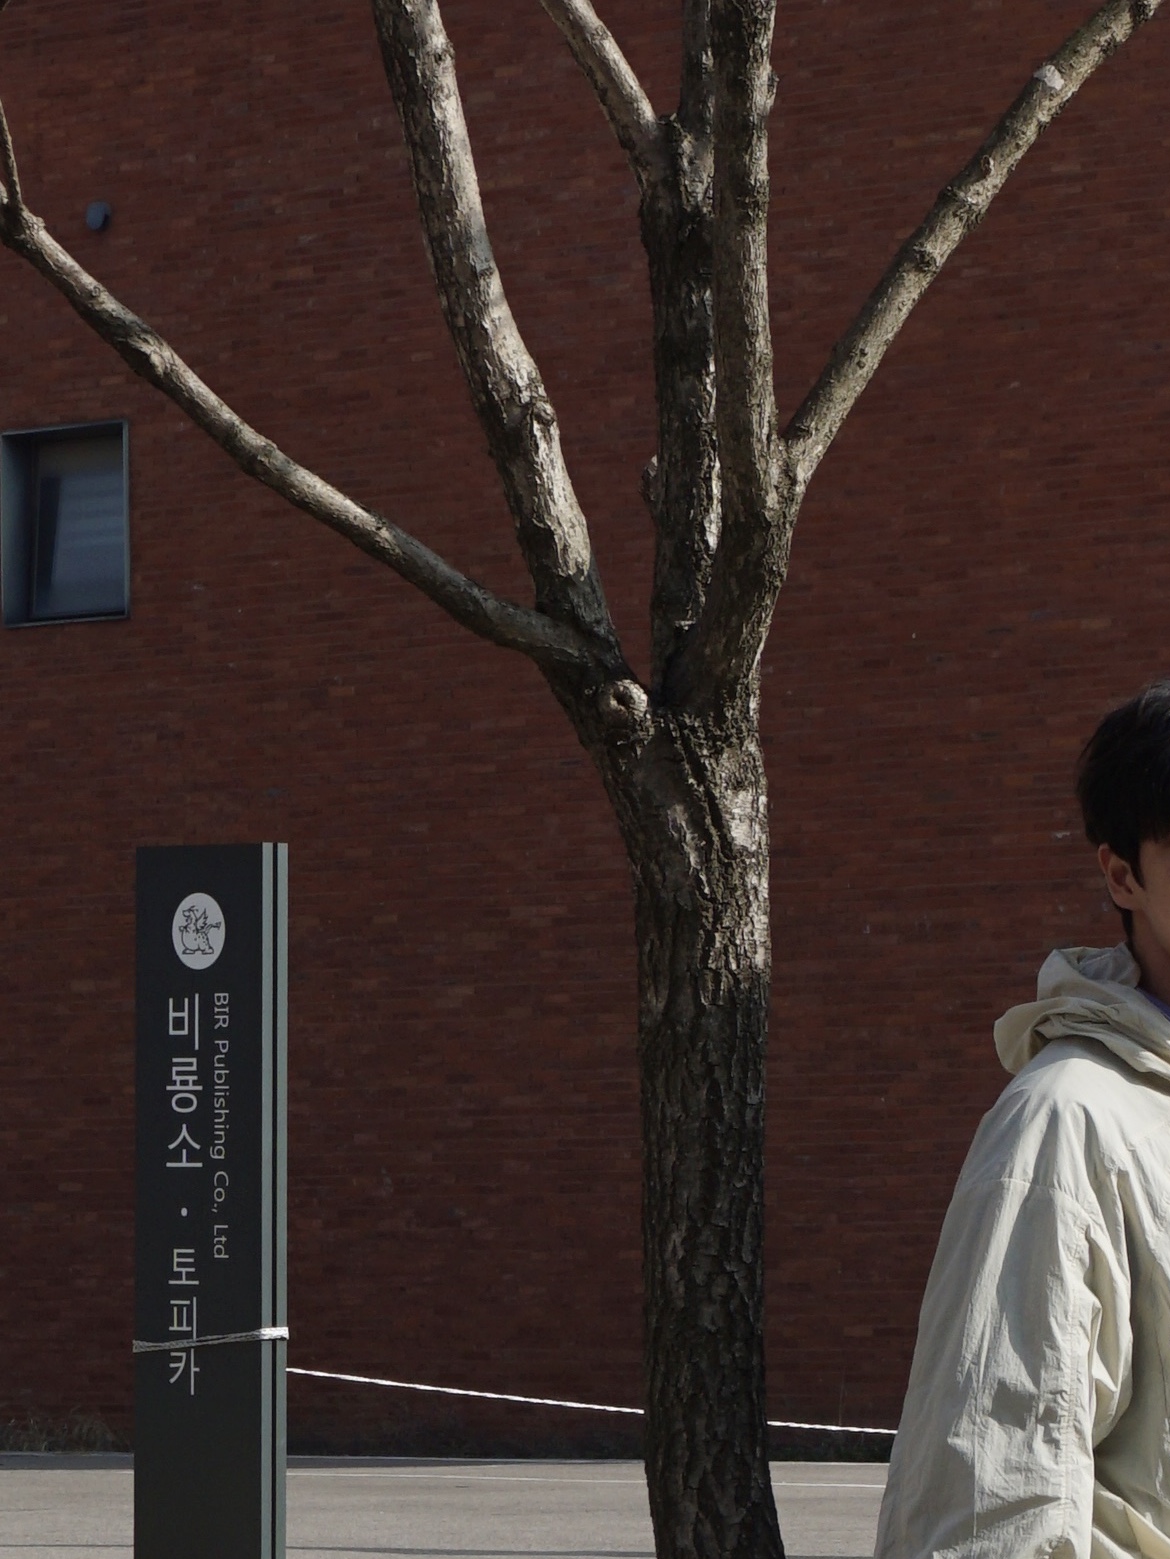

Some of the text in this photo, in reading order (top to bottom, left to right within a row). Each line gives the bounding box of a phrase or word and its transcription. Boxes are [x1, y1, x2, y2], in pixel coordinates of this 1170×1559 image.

[213, 991, 229, 1030] BIR
[165, 992, 204, 1171] 비룡소
[211, 1038, 229, 1162] Publishing
[213, 1224, 229, 1260] Ltd
[168, 1247, 201, 1397] 토피카
